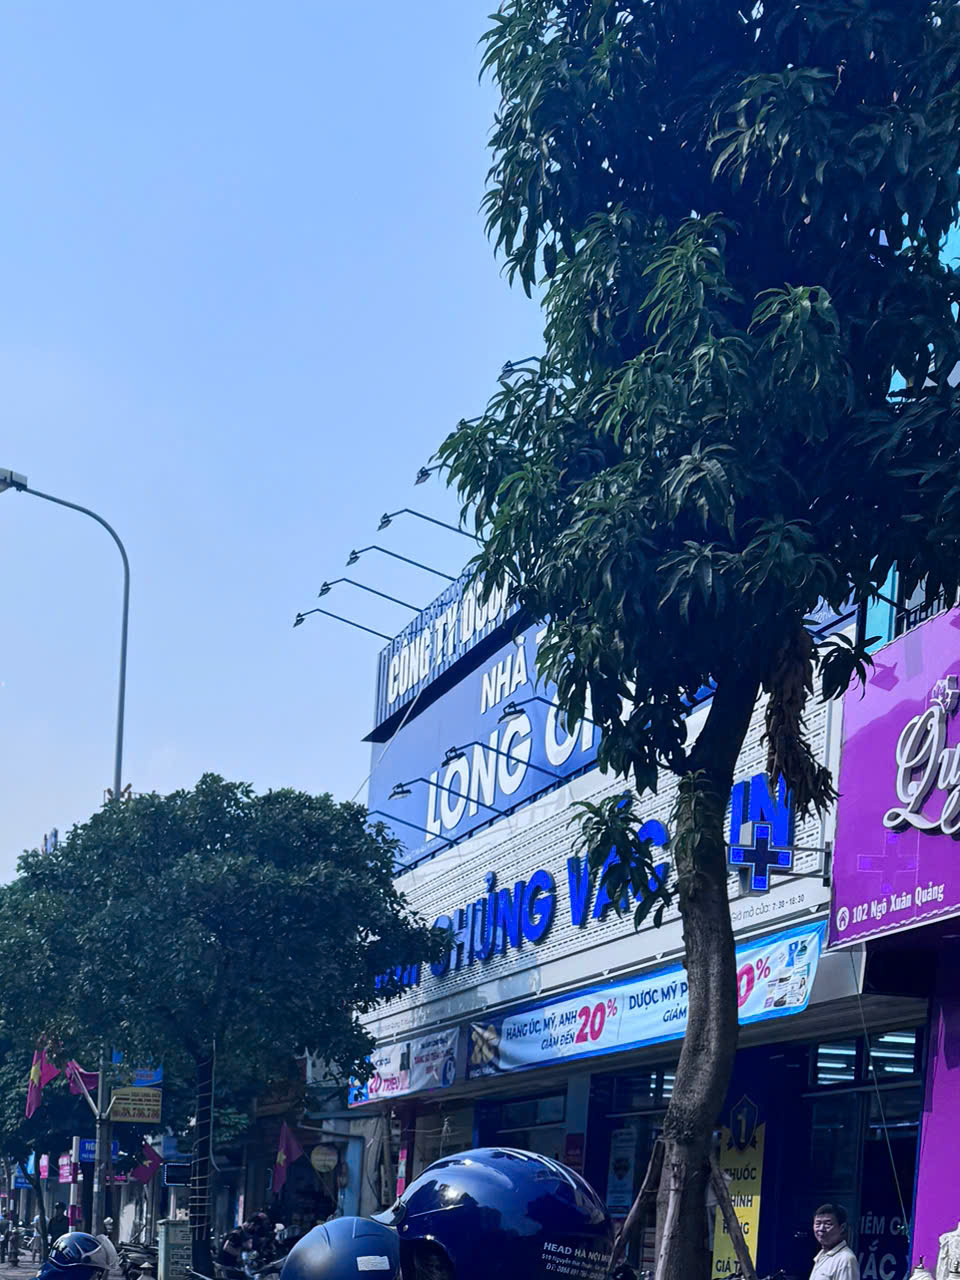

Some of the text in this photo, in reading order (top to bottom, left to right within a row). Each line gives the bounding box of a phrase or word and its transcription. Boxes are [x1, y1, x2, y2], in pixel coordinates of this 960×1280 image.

[387, 627, 432, 704] CÔNG
[434, 601, 459, 667] TY
[480, 634, 528, 715] NHÀ
[425, 708, 533, 843] LONG
[851, 881, 945, 924] 102 Ngô Xuân Quảng
[558, 1009, 578, 1026] ANH
[575, 998, 618, 1044] 20%
[628, 989, 659, 1011] DƯỢC
[663, 1003, 688, 1023] GIẢM
[543, 1242, 573, 1255] HEAD
